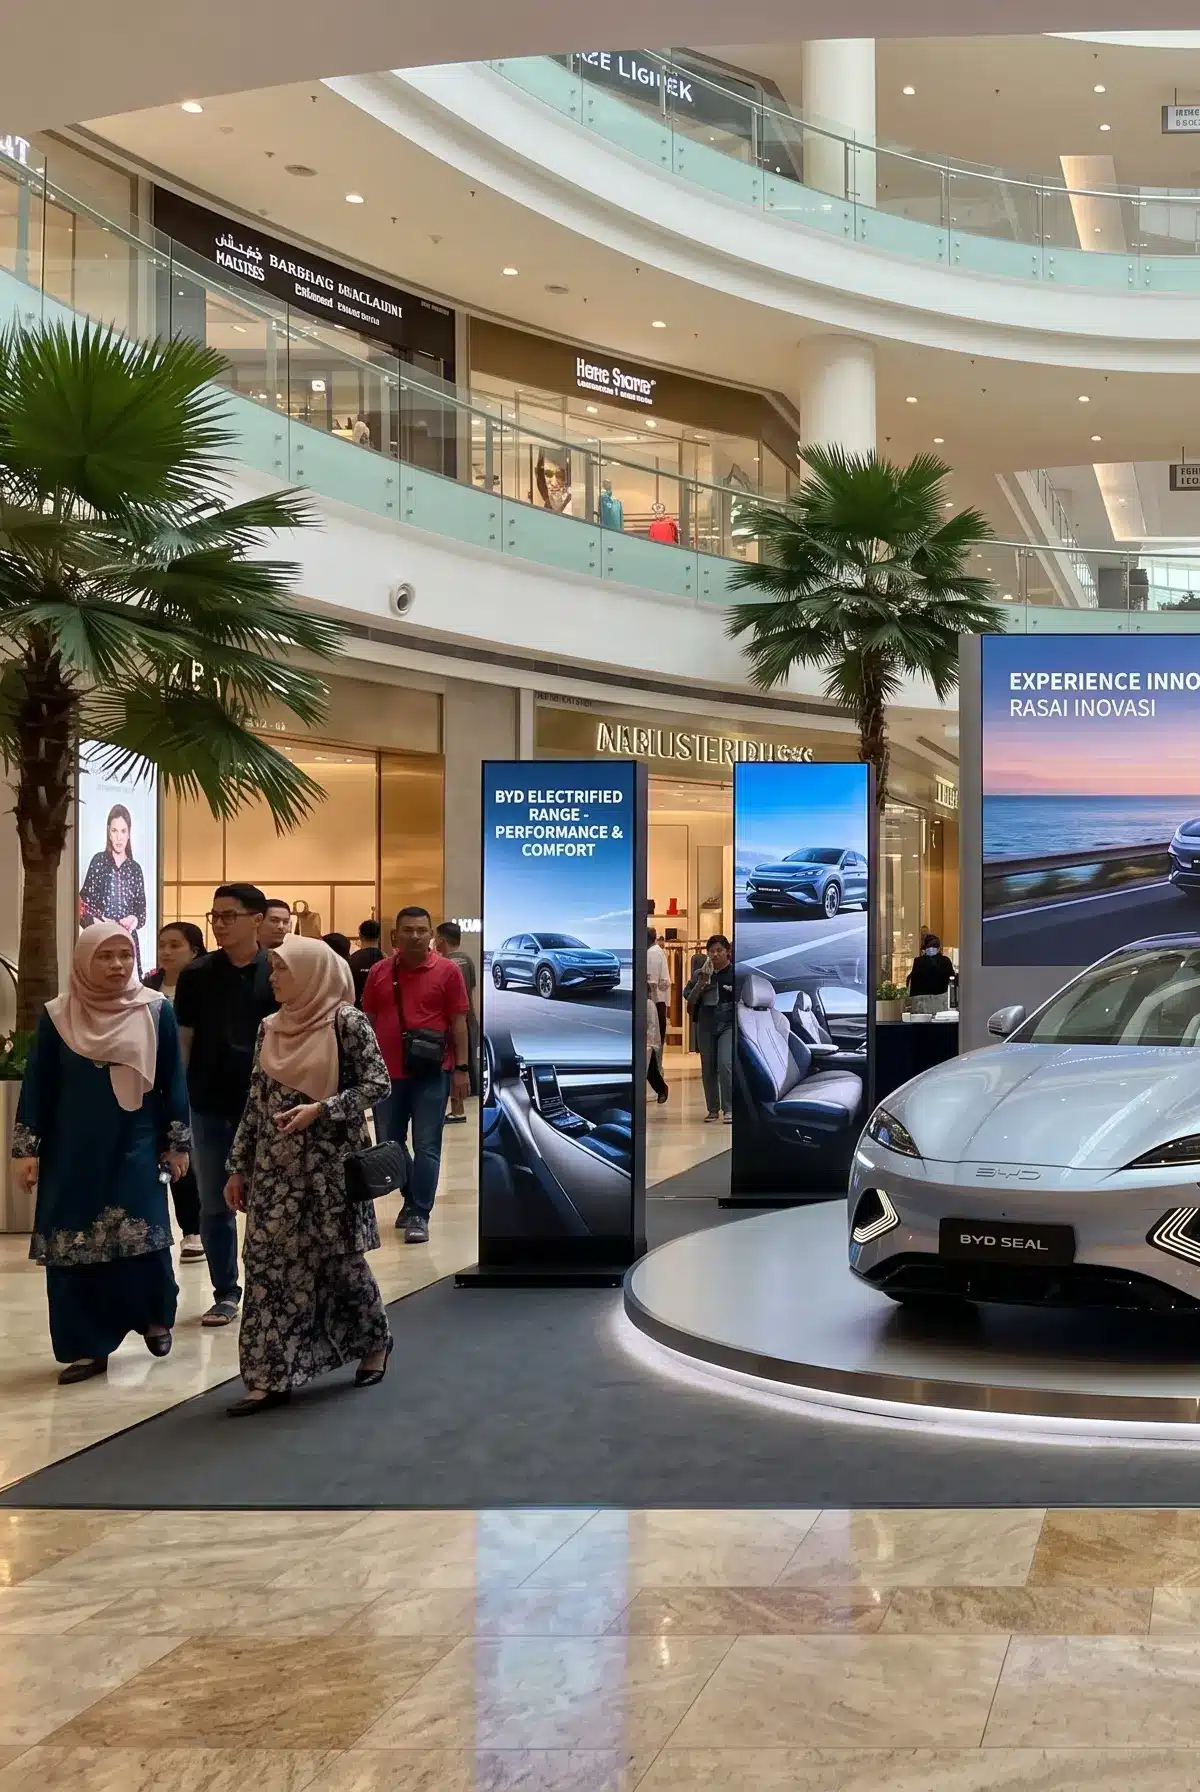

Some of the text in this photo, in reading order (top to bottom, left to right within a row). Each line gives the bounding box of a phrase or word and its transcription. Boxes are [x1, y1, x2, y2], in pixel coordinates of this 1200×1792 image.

[1009, 672, 1141, 691] EXPERIENCE
[1010, 698, 1156, 717] RASAI INOVASI
[495, 790, 623, 804] BYD ELECTRIFIED
[529, 808, 580, 821] RANGE
[495, 825, 623, 839] PERFORMANCE &
[521, 843, 595, 857] COMFORT
[976, 1167, 1041, 1180] BYD
[960, 1234, 1049, 1251] BYD SEAL
